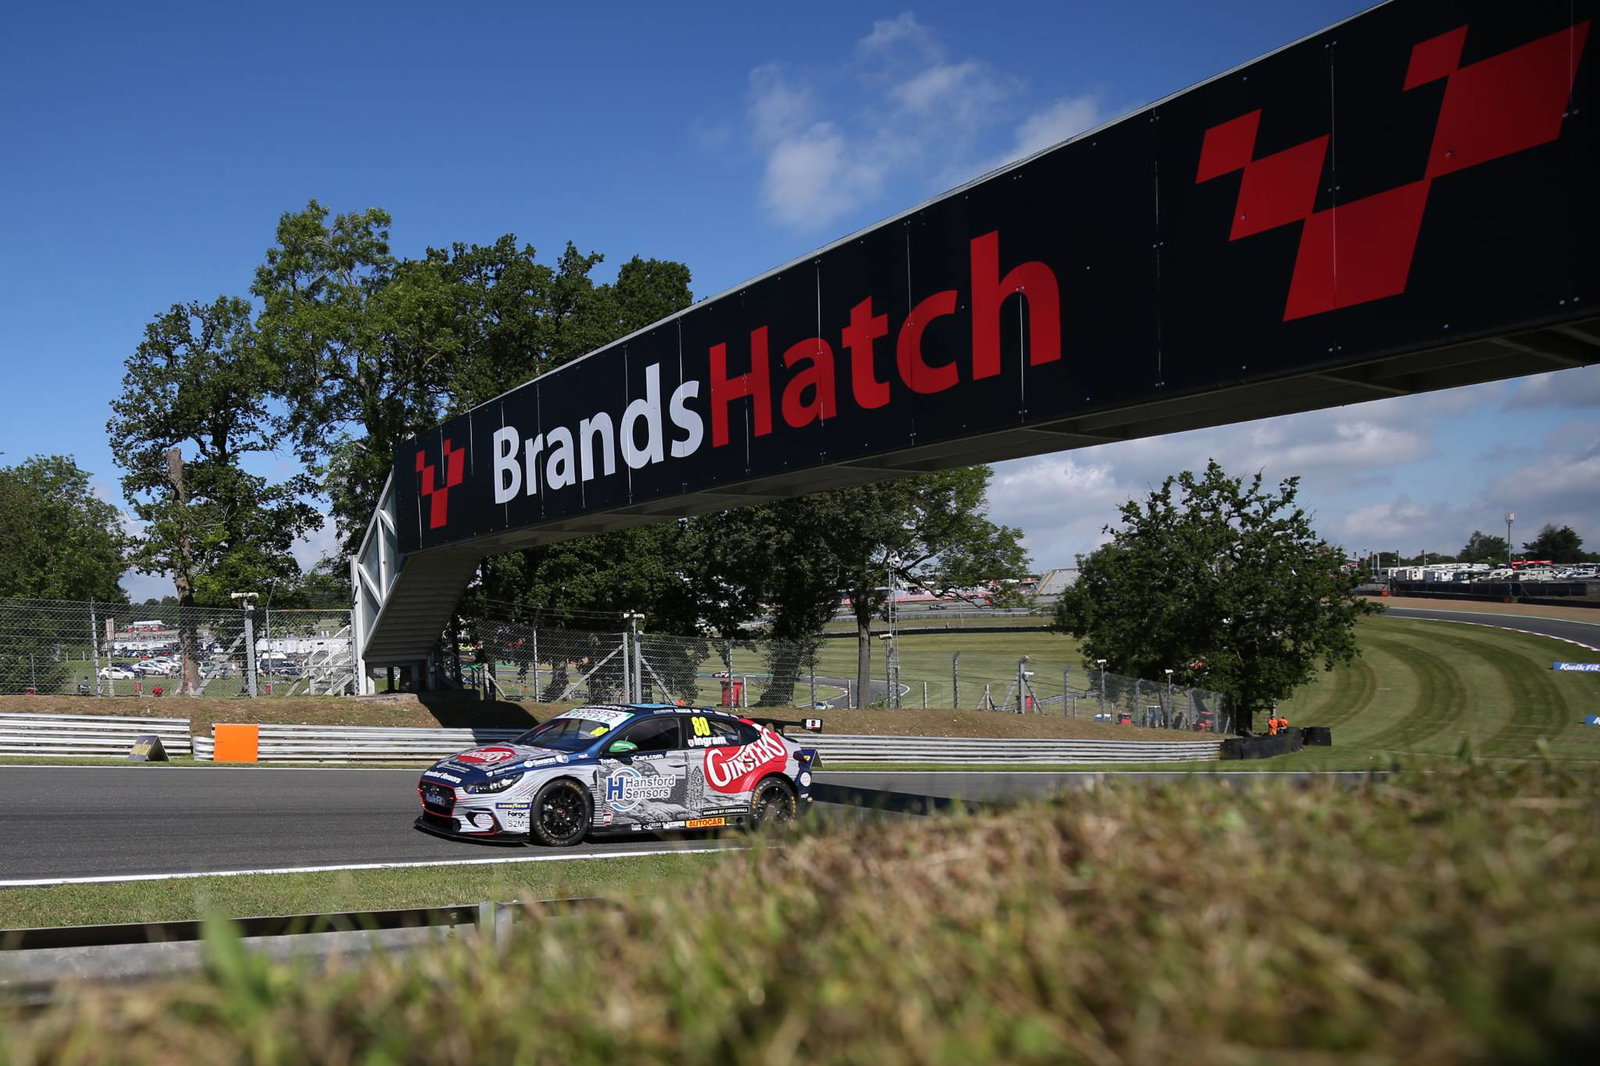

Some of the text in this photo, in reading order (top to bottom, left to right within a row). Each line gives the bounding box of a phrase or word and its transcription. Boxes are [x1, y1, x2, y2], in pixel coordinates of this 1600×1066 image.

[690, 716, 711, 736] 80
[694, 735, 727, 748] Ingram
[625, 774, 676, 789] Hansford
[624, 787, 671, 800] Sensors
[507, 820, 525, 828] S2M
[688, 818, 723, 828] AUTOCAR
